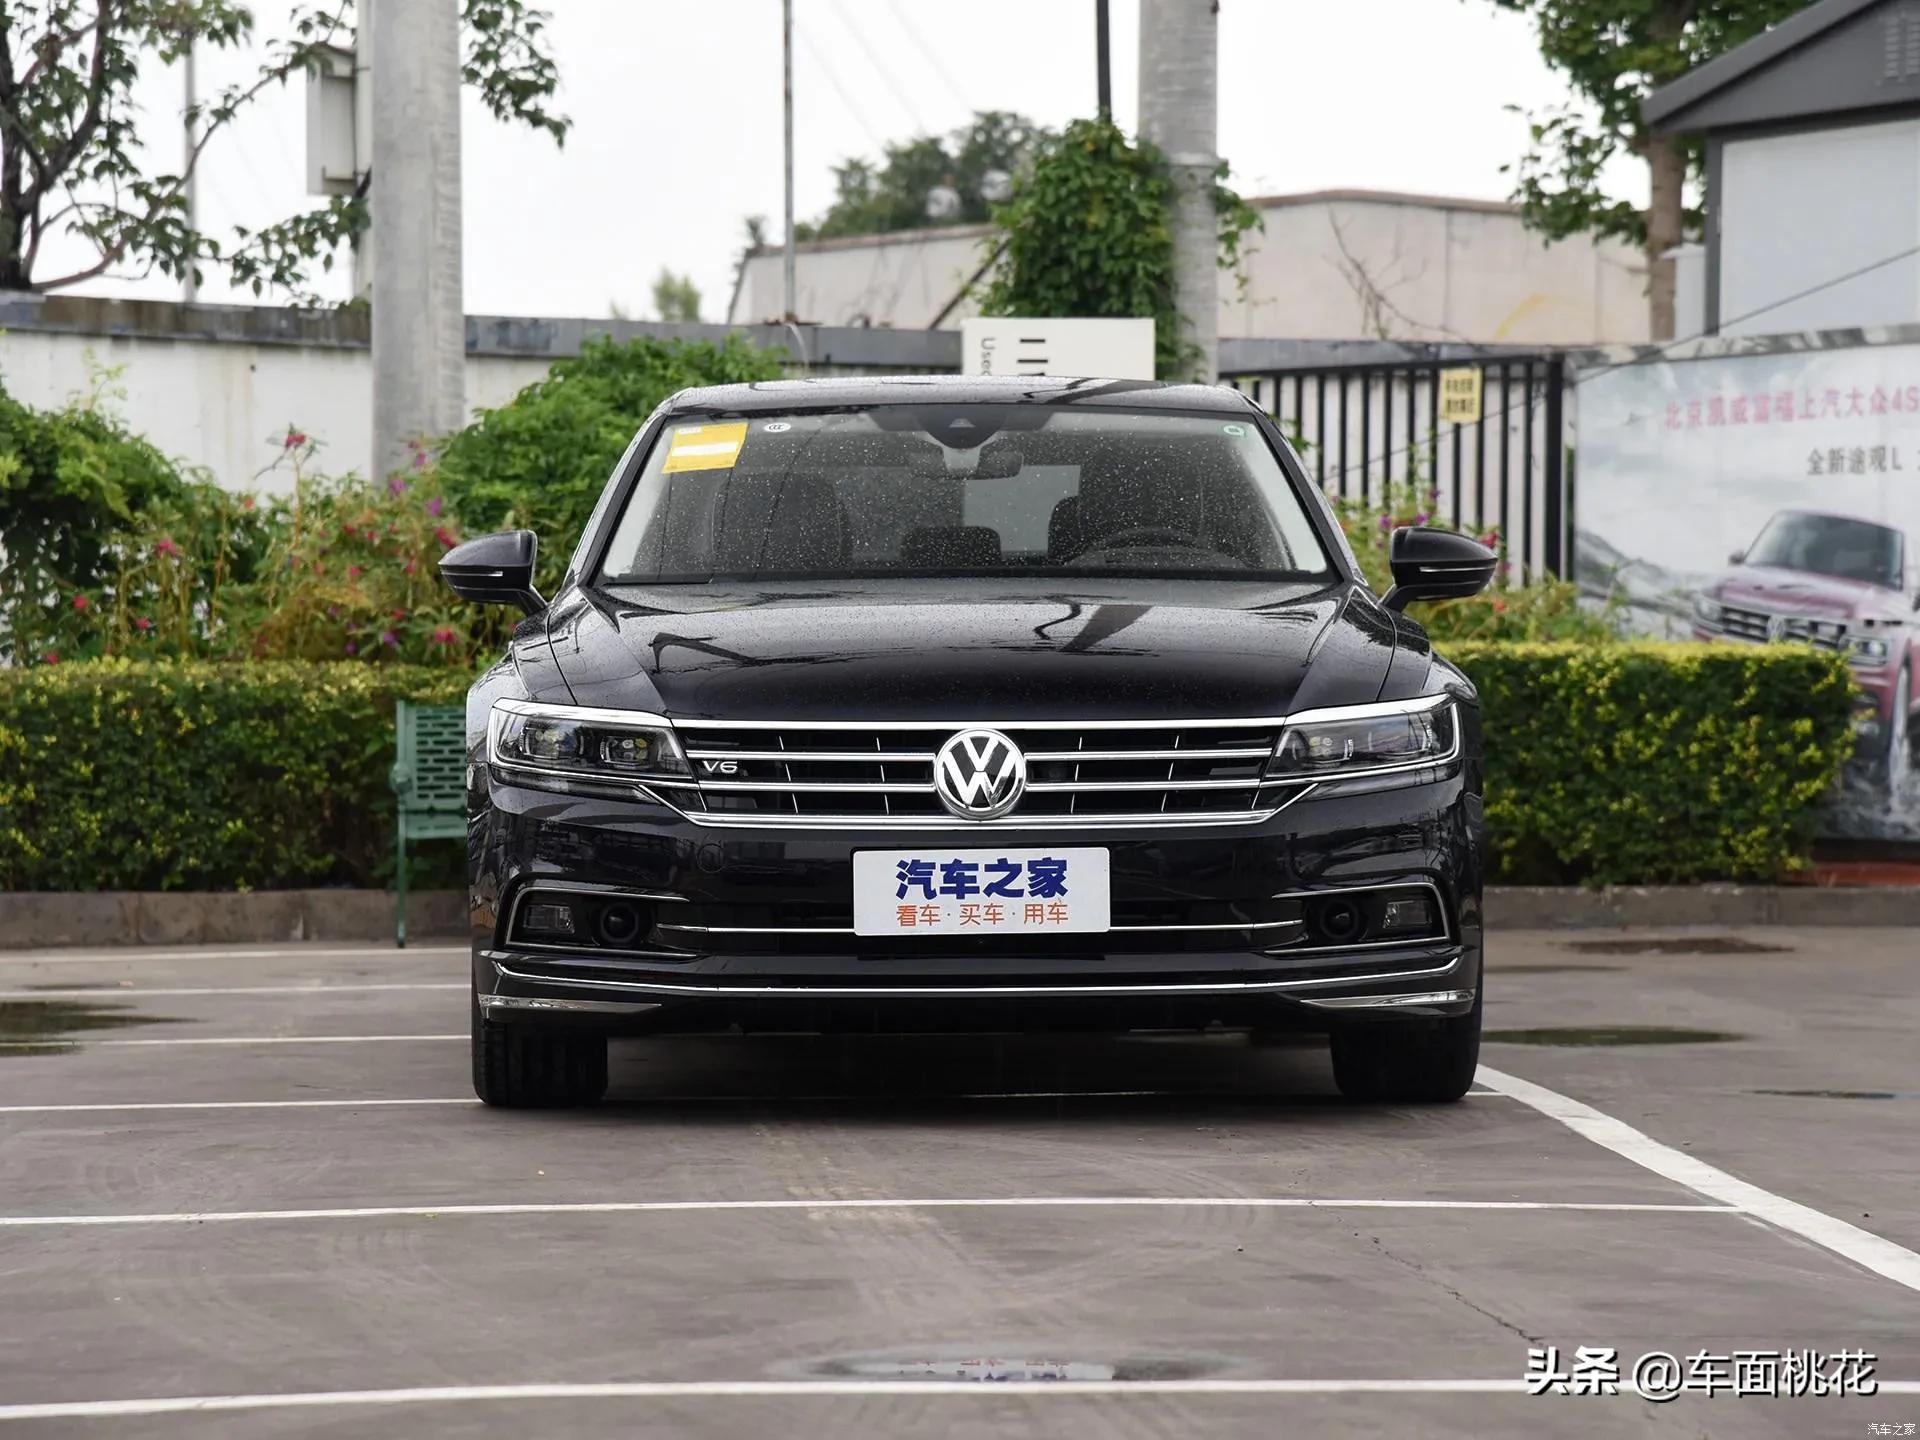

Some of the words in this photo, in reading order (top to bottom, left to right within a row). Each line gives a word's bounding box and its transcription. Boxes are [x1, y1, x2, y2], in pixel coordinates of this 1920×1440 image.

[1017, 338, 1049, 376] 二
[702, 760, 738, 774] V6
[896, 857, 1068, 900] 汽车之家
